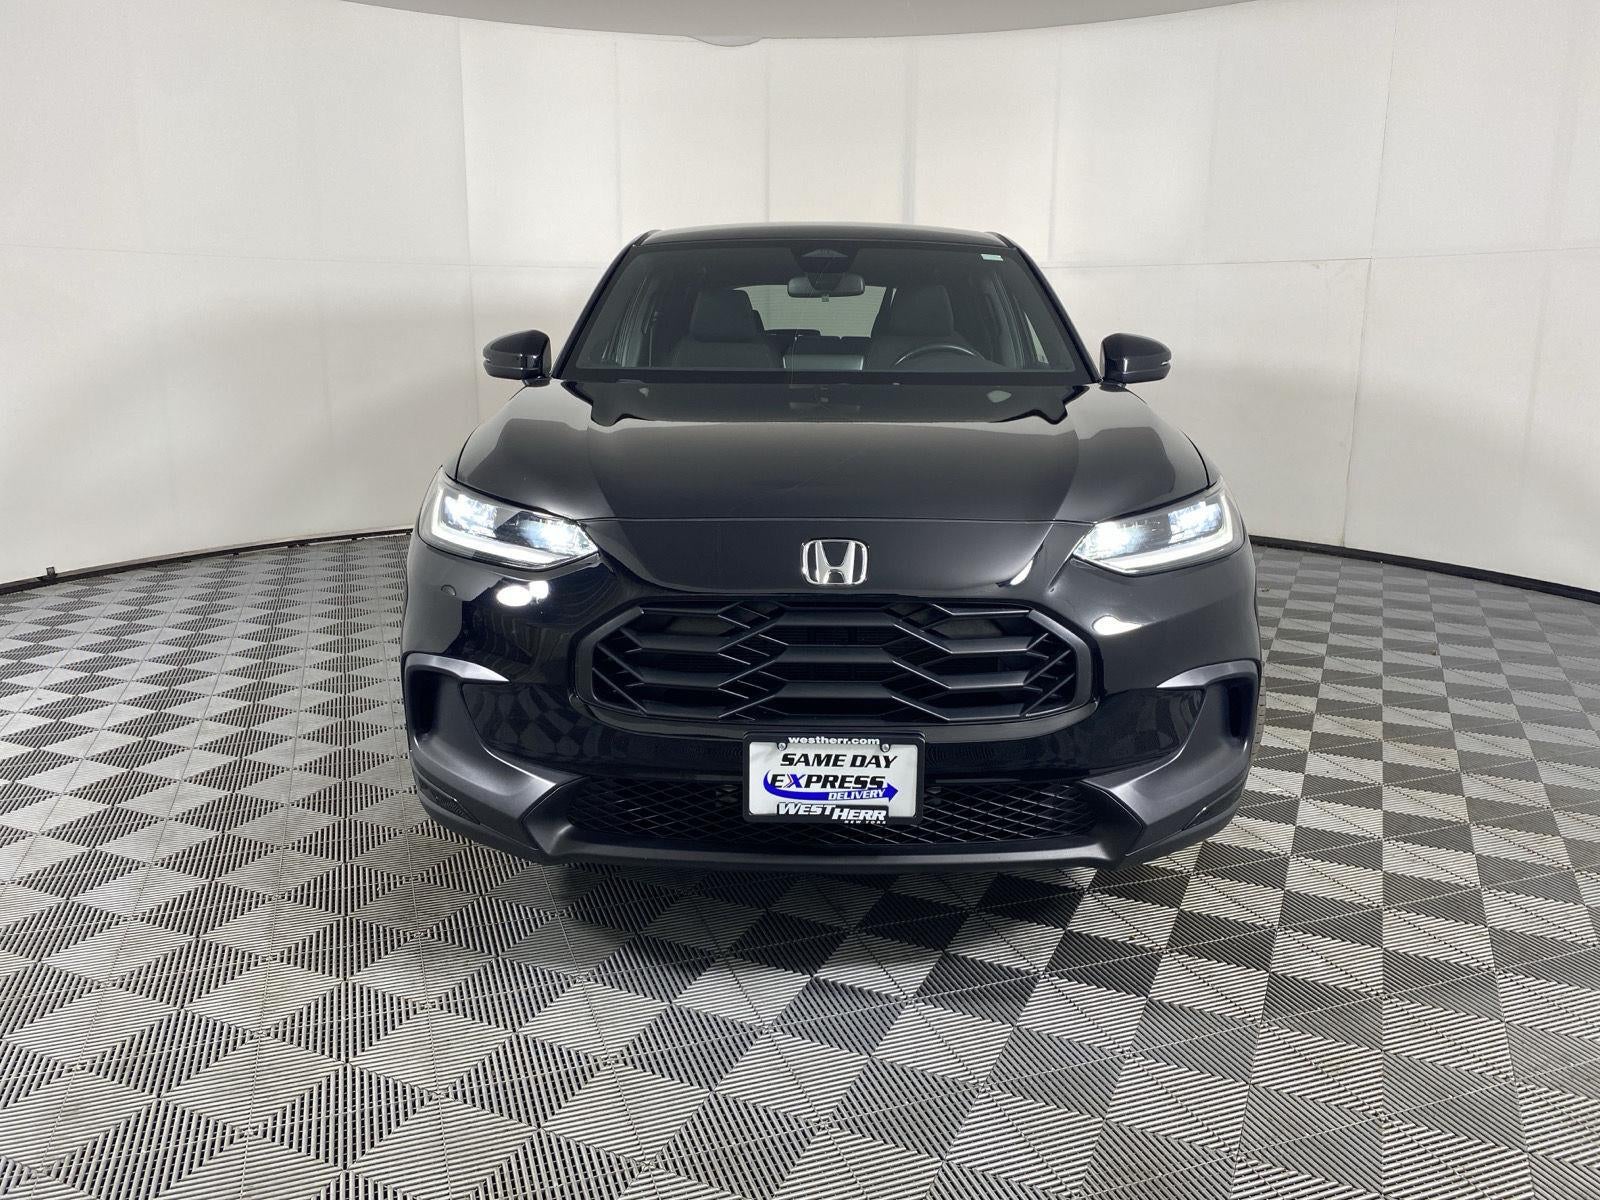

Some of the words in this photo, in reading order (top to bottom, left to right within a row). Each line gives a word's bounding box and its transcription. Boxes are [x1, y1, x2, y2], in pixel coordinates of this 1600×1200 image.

[788, 736, 880, 745] westherr.com
[780, 753, 847, 767] SAME
[850, 755, 897, 768] DAY
[771, 774, 886, 789] EXPRESS
[828, 788, 885, 800] DELIVERY
